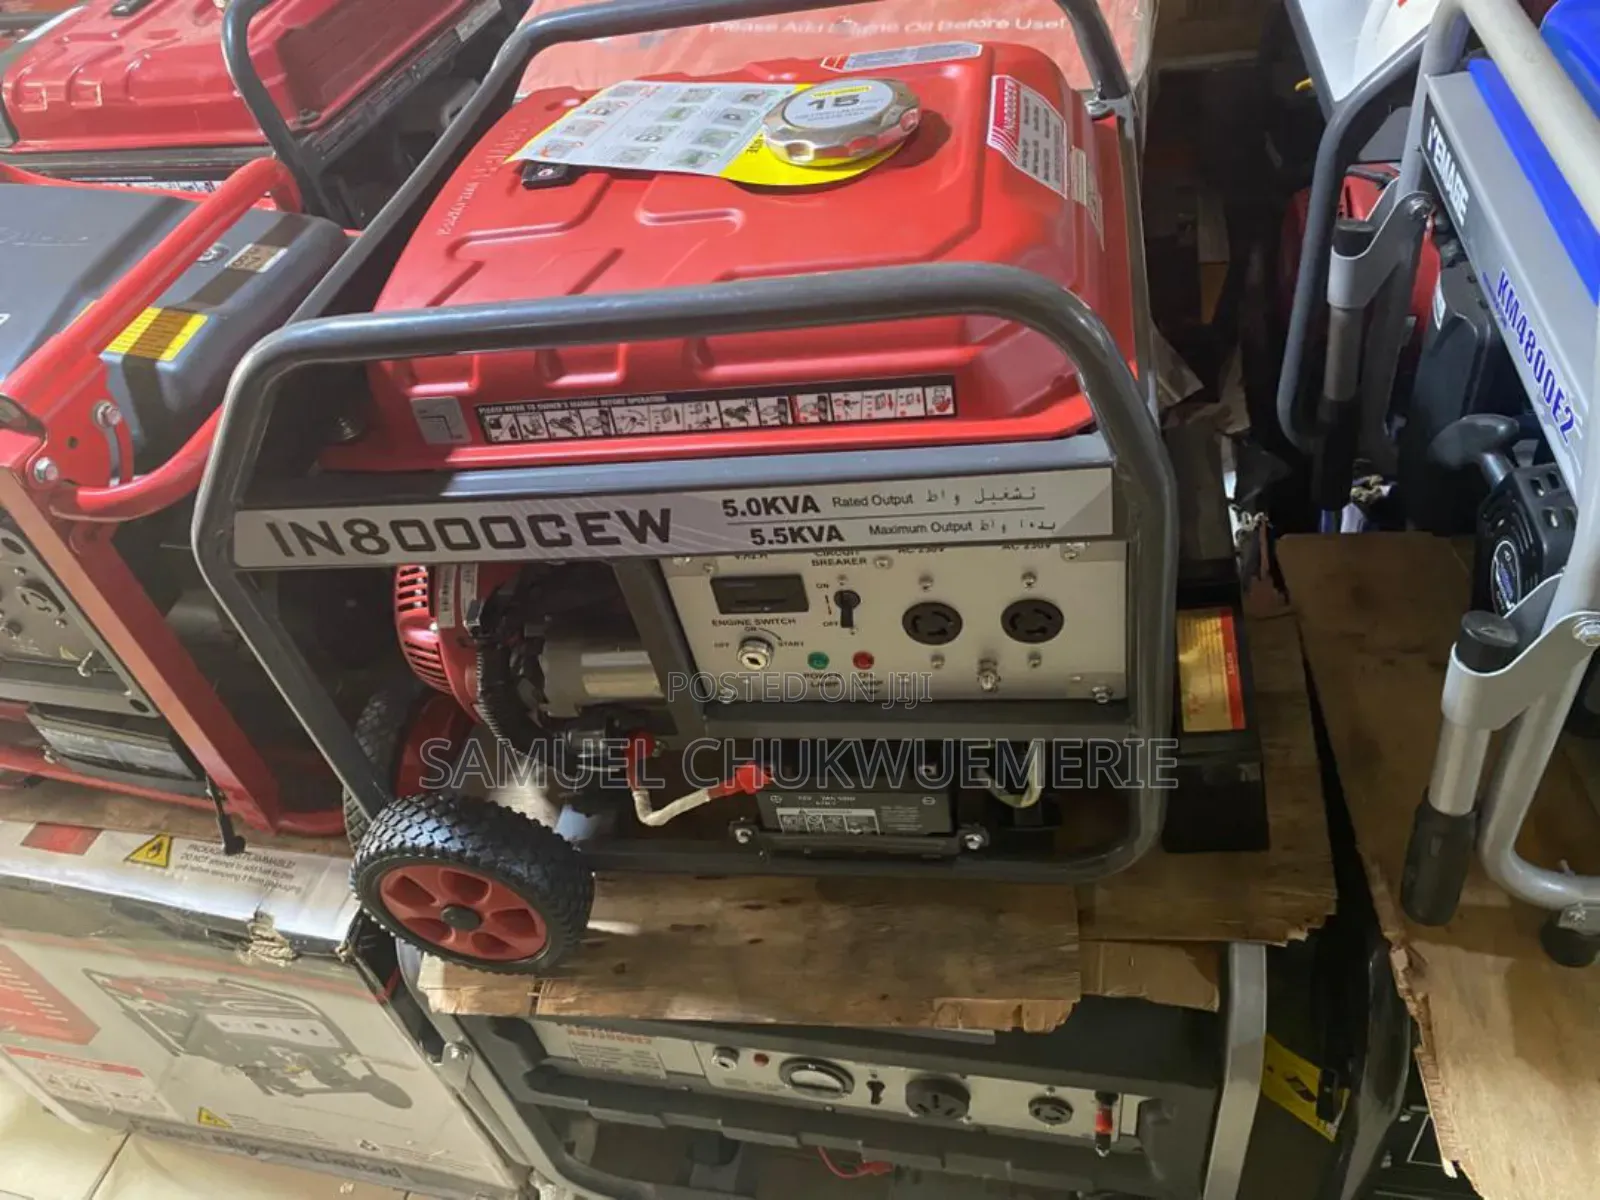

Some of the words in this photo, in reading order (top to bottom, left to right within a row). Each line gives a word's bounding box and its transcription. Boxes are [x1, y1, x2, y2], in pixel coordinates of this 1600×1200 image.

[709, 21, 772, 34] Please
[787, 20, 822, 34] Add
[905, 20, 933, 34] Oil
[938, 18, 1010, 34] Before
[1015, 17, 1068, 31] Use!
[807, 93, 861, 111] 15
[1497, 266, 1579, 445] KM4800E2
[721, 493, 821, 519] 5.0KVA
[832, 495, 869, 509] Rated
[872, 491, 914, 510] Output
[265, 507, 672, 559] IN8000CEW
[749, 523, 845, 547] 5.5KVA
[869, 521, 928, 537] Maximum
[931, 519, 974, 537] Output
[811, 557, 868, 567] BREAKER
[816, 582, 830, 590] ON
[711, 618, 752, 627] ENGINE
[754, 618, 797, 627] SWITCH
[822, 620, 839, 628] OFF
[777, 640, 805, 648] START
